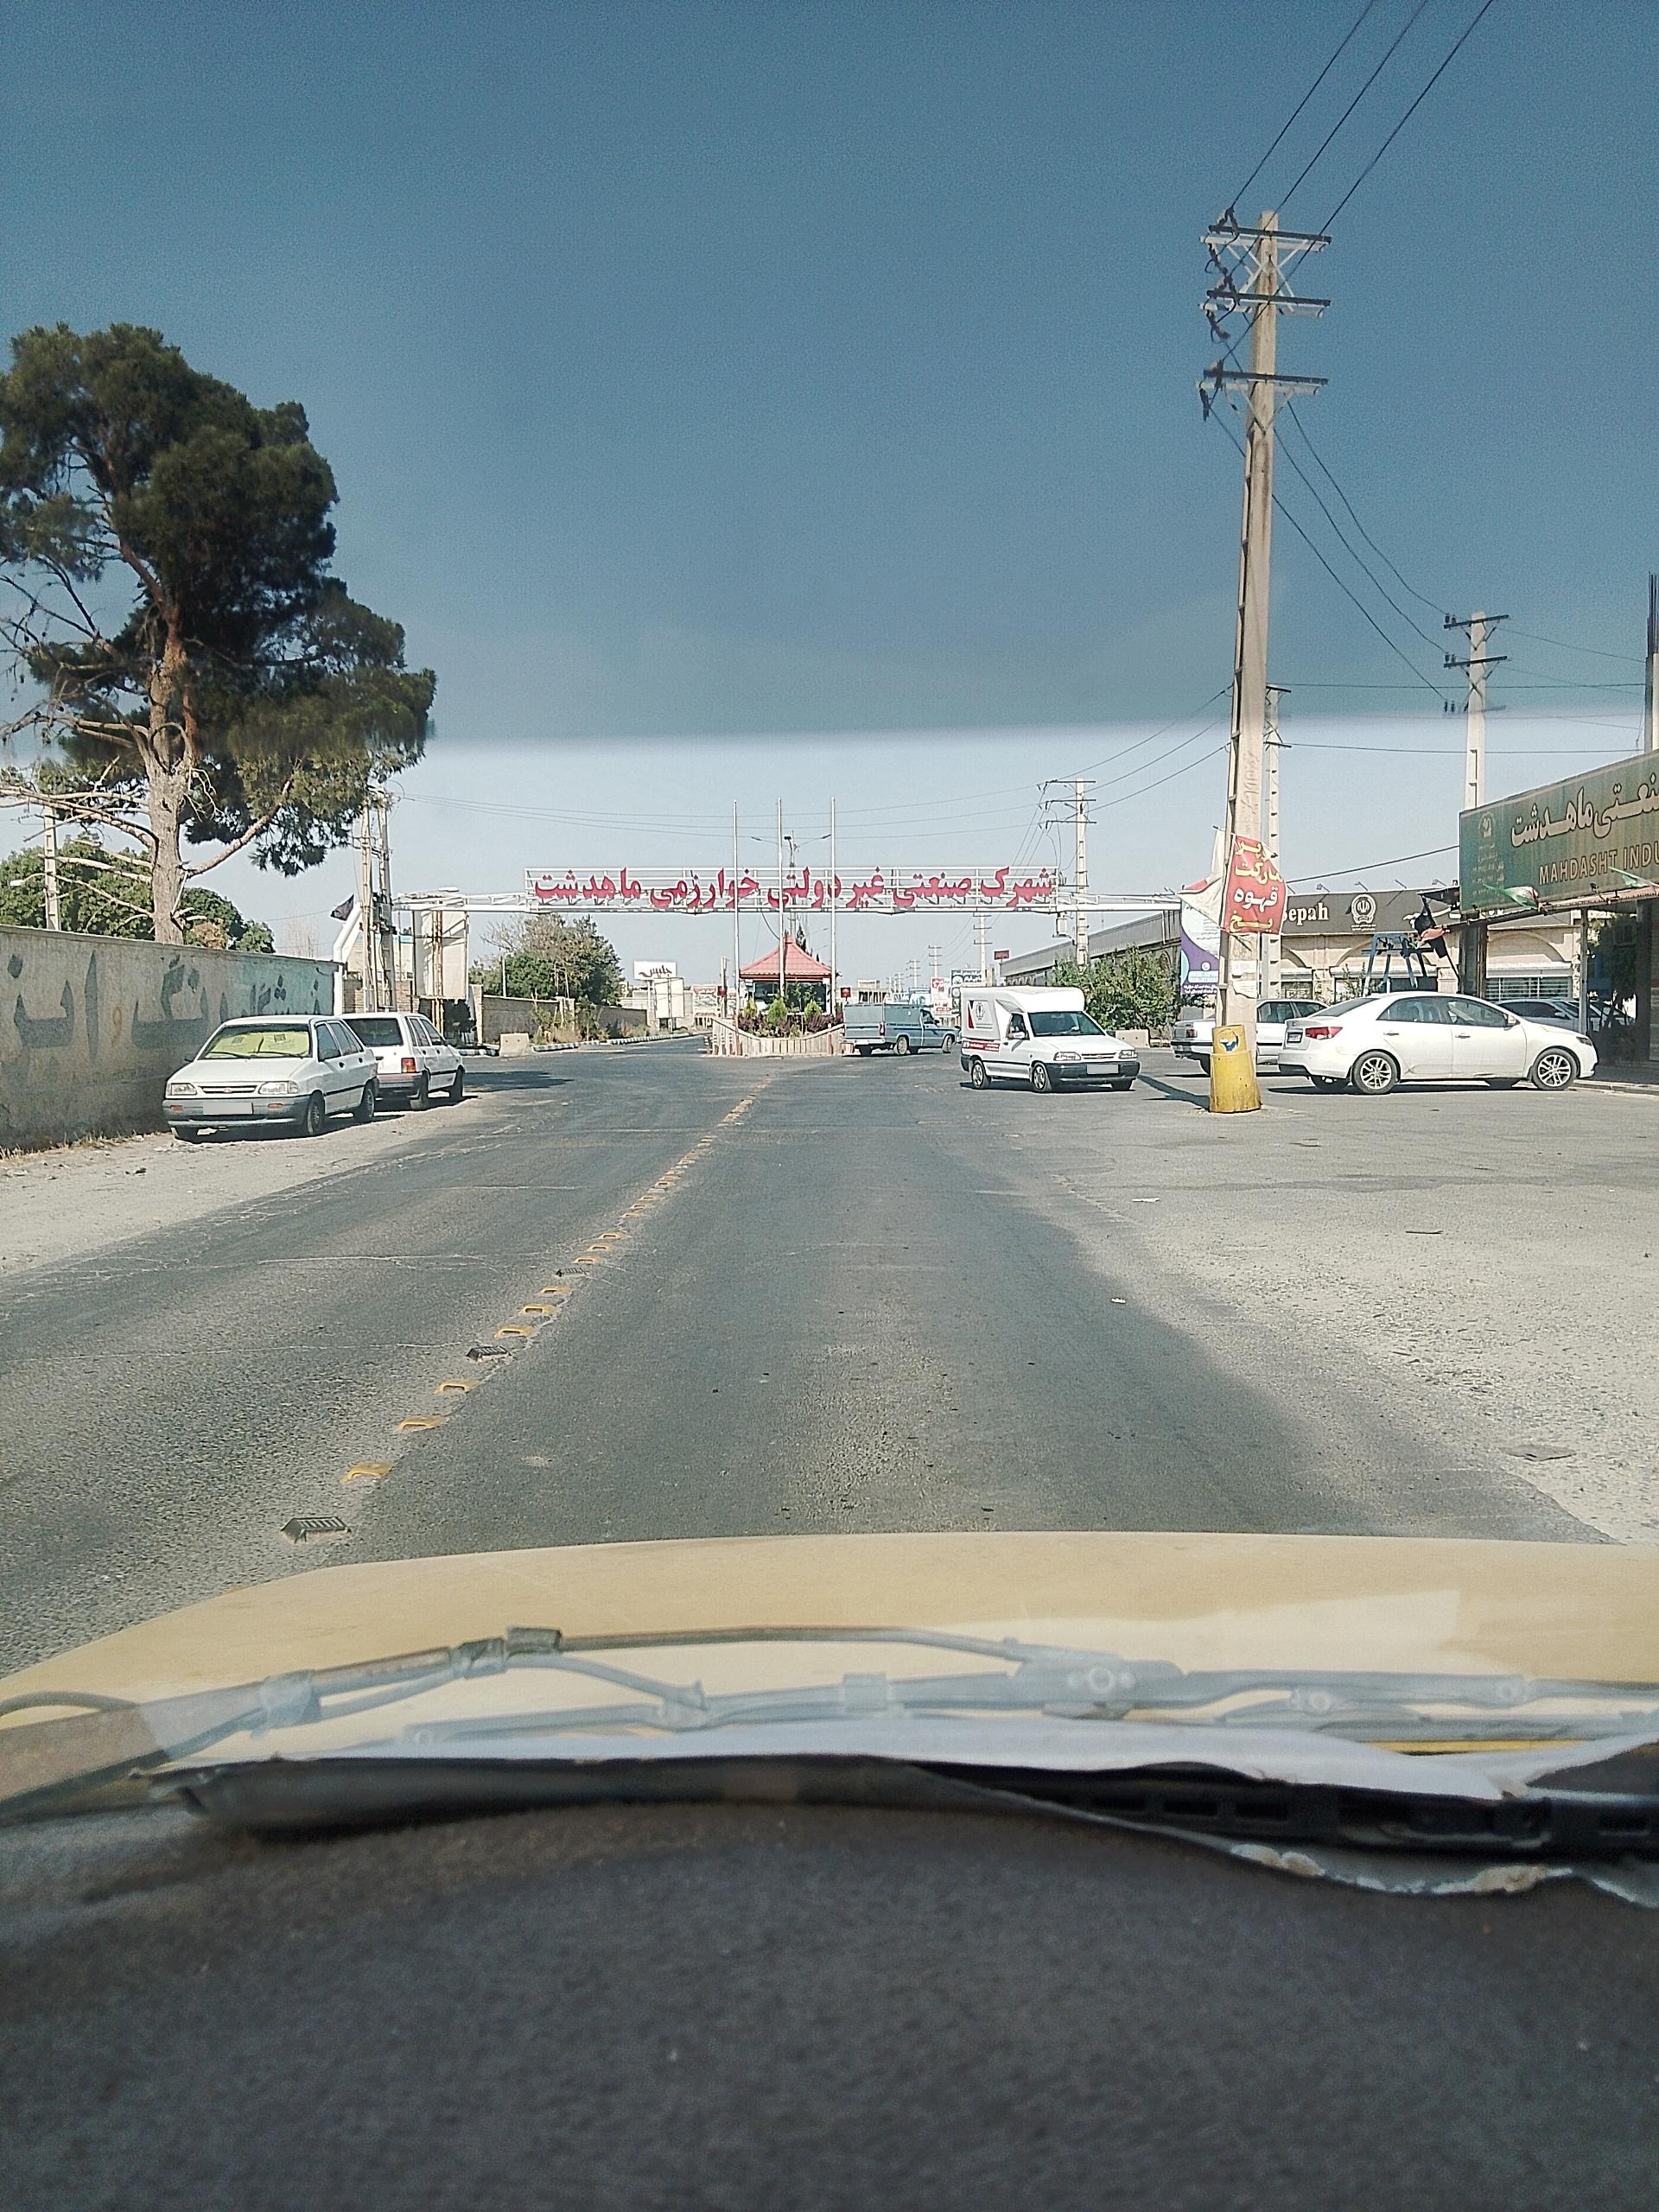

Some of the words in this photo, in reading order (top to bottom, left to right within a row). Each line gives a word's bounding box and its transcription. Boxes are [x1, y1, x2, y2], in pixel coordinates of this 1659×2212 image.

[1510, 785, 1594, 848] ماهدشت
[1592, 772, 1659, 839] نعتی
[534, 868, 642, 899] ماهدشت
[979, 867, 1052, 906] شهرک
[1538, 849, 1618, 887] MAHDASHT
[650, 868, 760, 908] خوارزمی
[893, 872, 973, 907] صنعتی
[1233, 886, 1279, 913] قهوه
[1230, 909, 1274, 934] یخ
